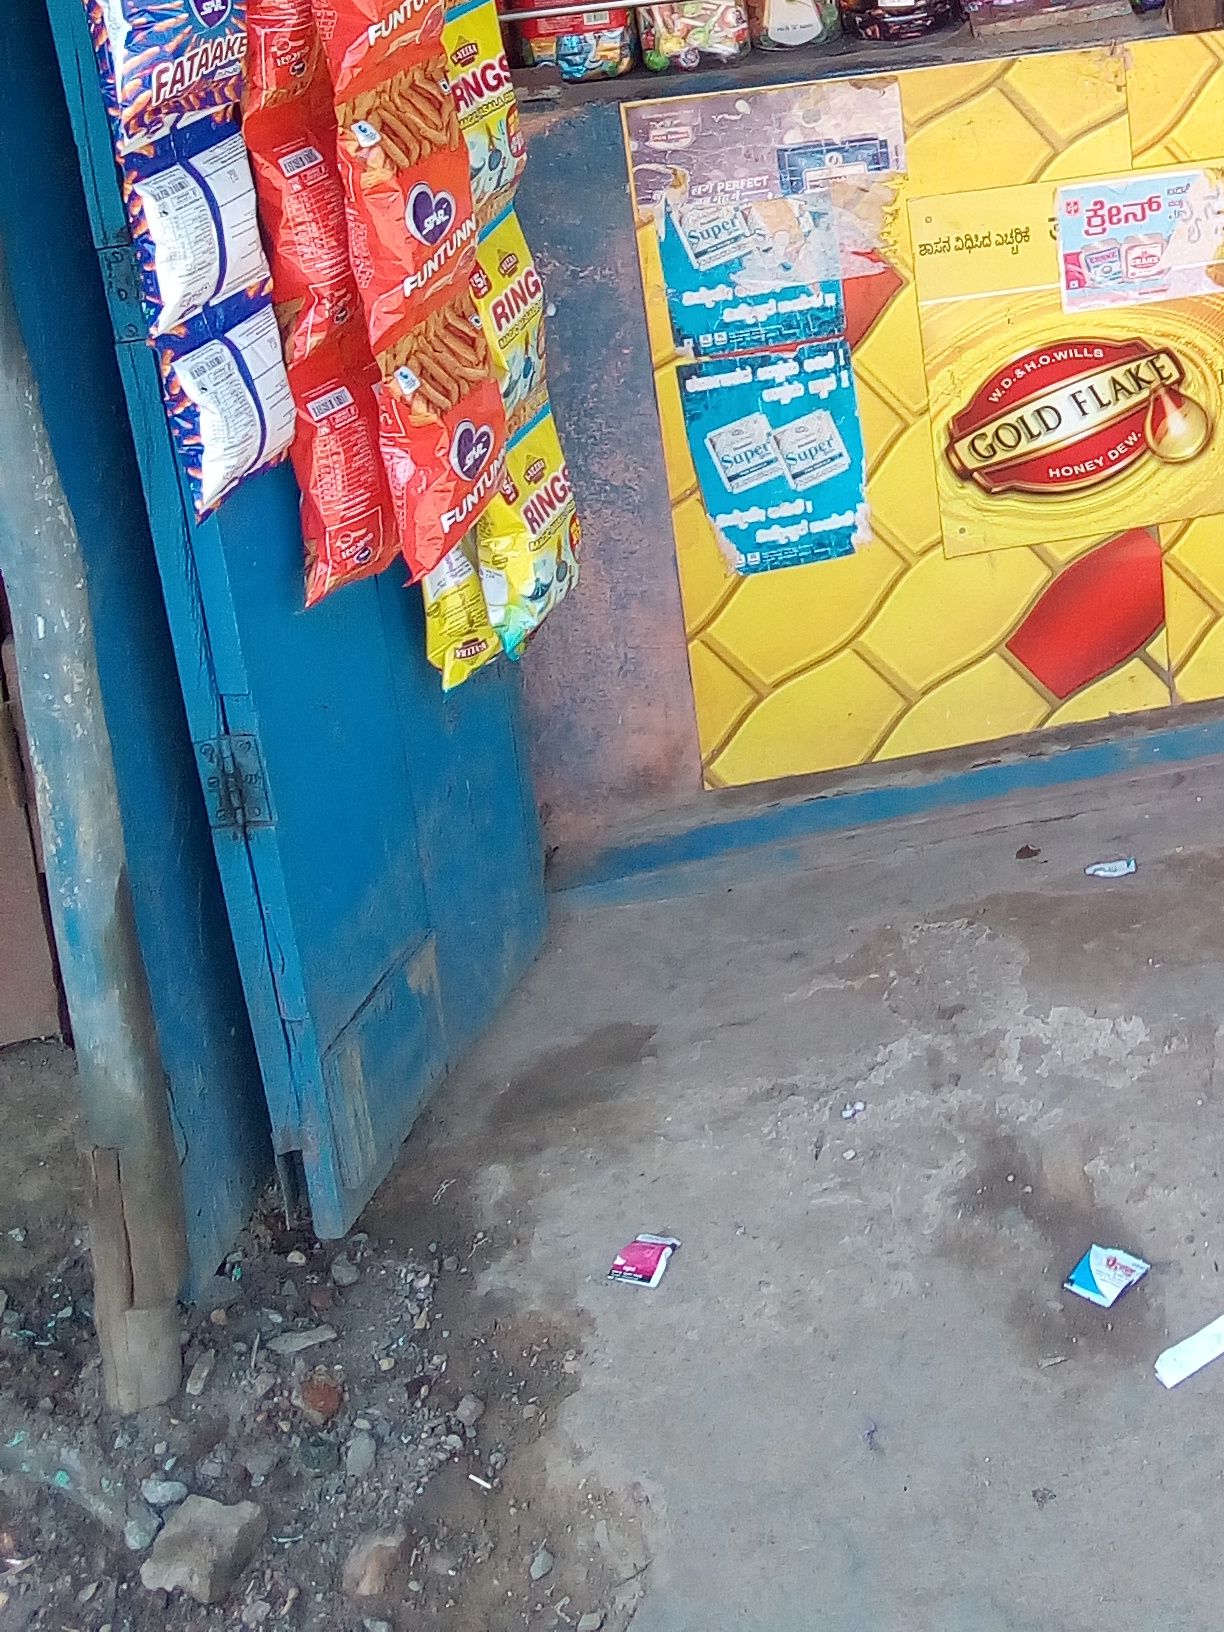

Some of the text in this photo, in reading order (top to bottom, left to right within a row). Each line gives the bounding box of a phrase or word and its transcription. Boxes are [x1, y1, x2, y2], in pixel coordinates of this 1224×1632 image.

[152, 33, 247, 106] FATAAKE
[717, 176, 769, 192] PERFECT
[1084, 195, 1161, 236] ಕ್ರೇನ್
[687, 218, 739, 247] Super
[919, 236, 950, 256] ಶಾಸನ
[954, 231, 992, 254] ವಿಧಿಸಿದ
[994, 226, 1030, 255] ಎಚ್ಚರಿಕೆ
[969, 354, 1173, 462] GOLD FLAKE
[721, 438, 769, 468] Super
[785, 437, 834, 465] Super
[1049, 457, 1105, 479] HONEY
